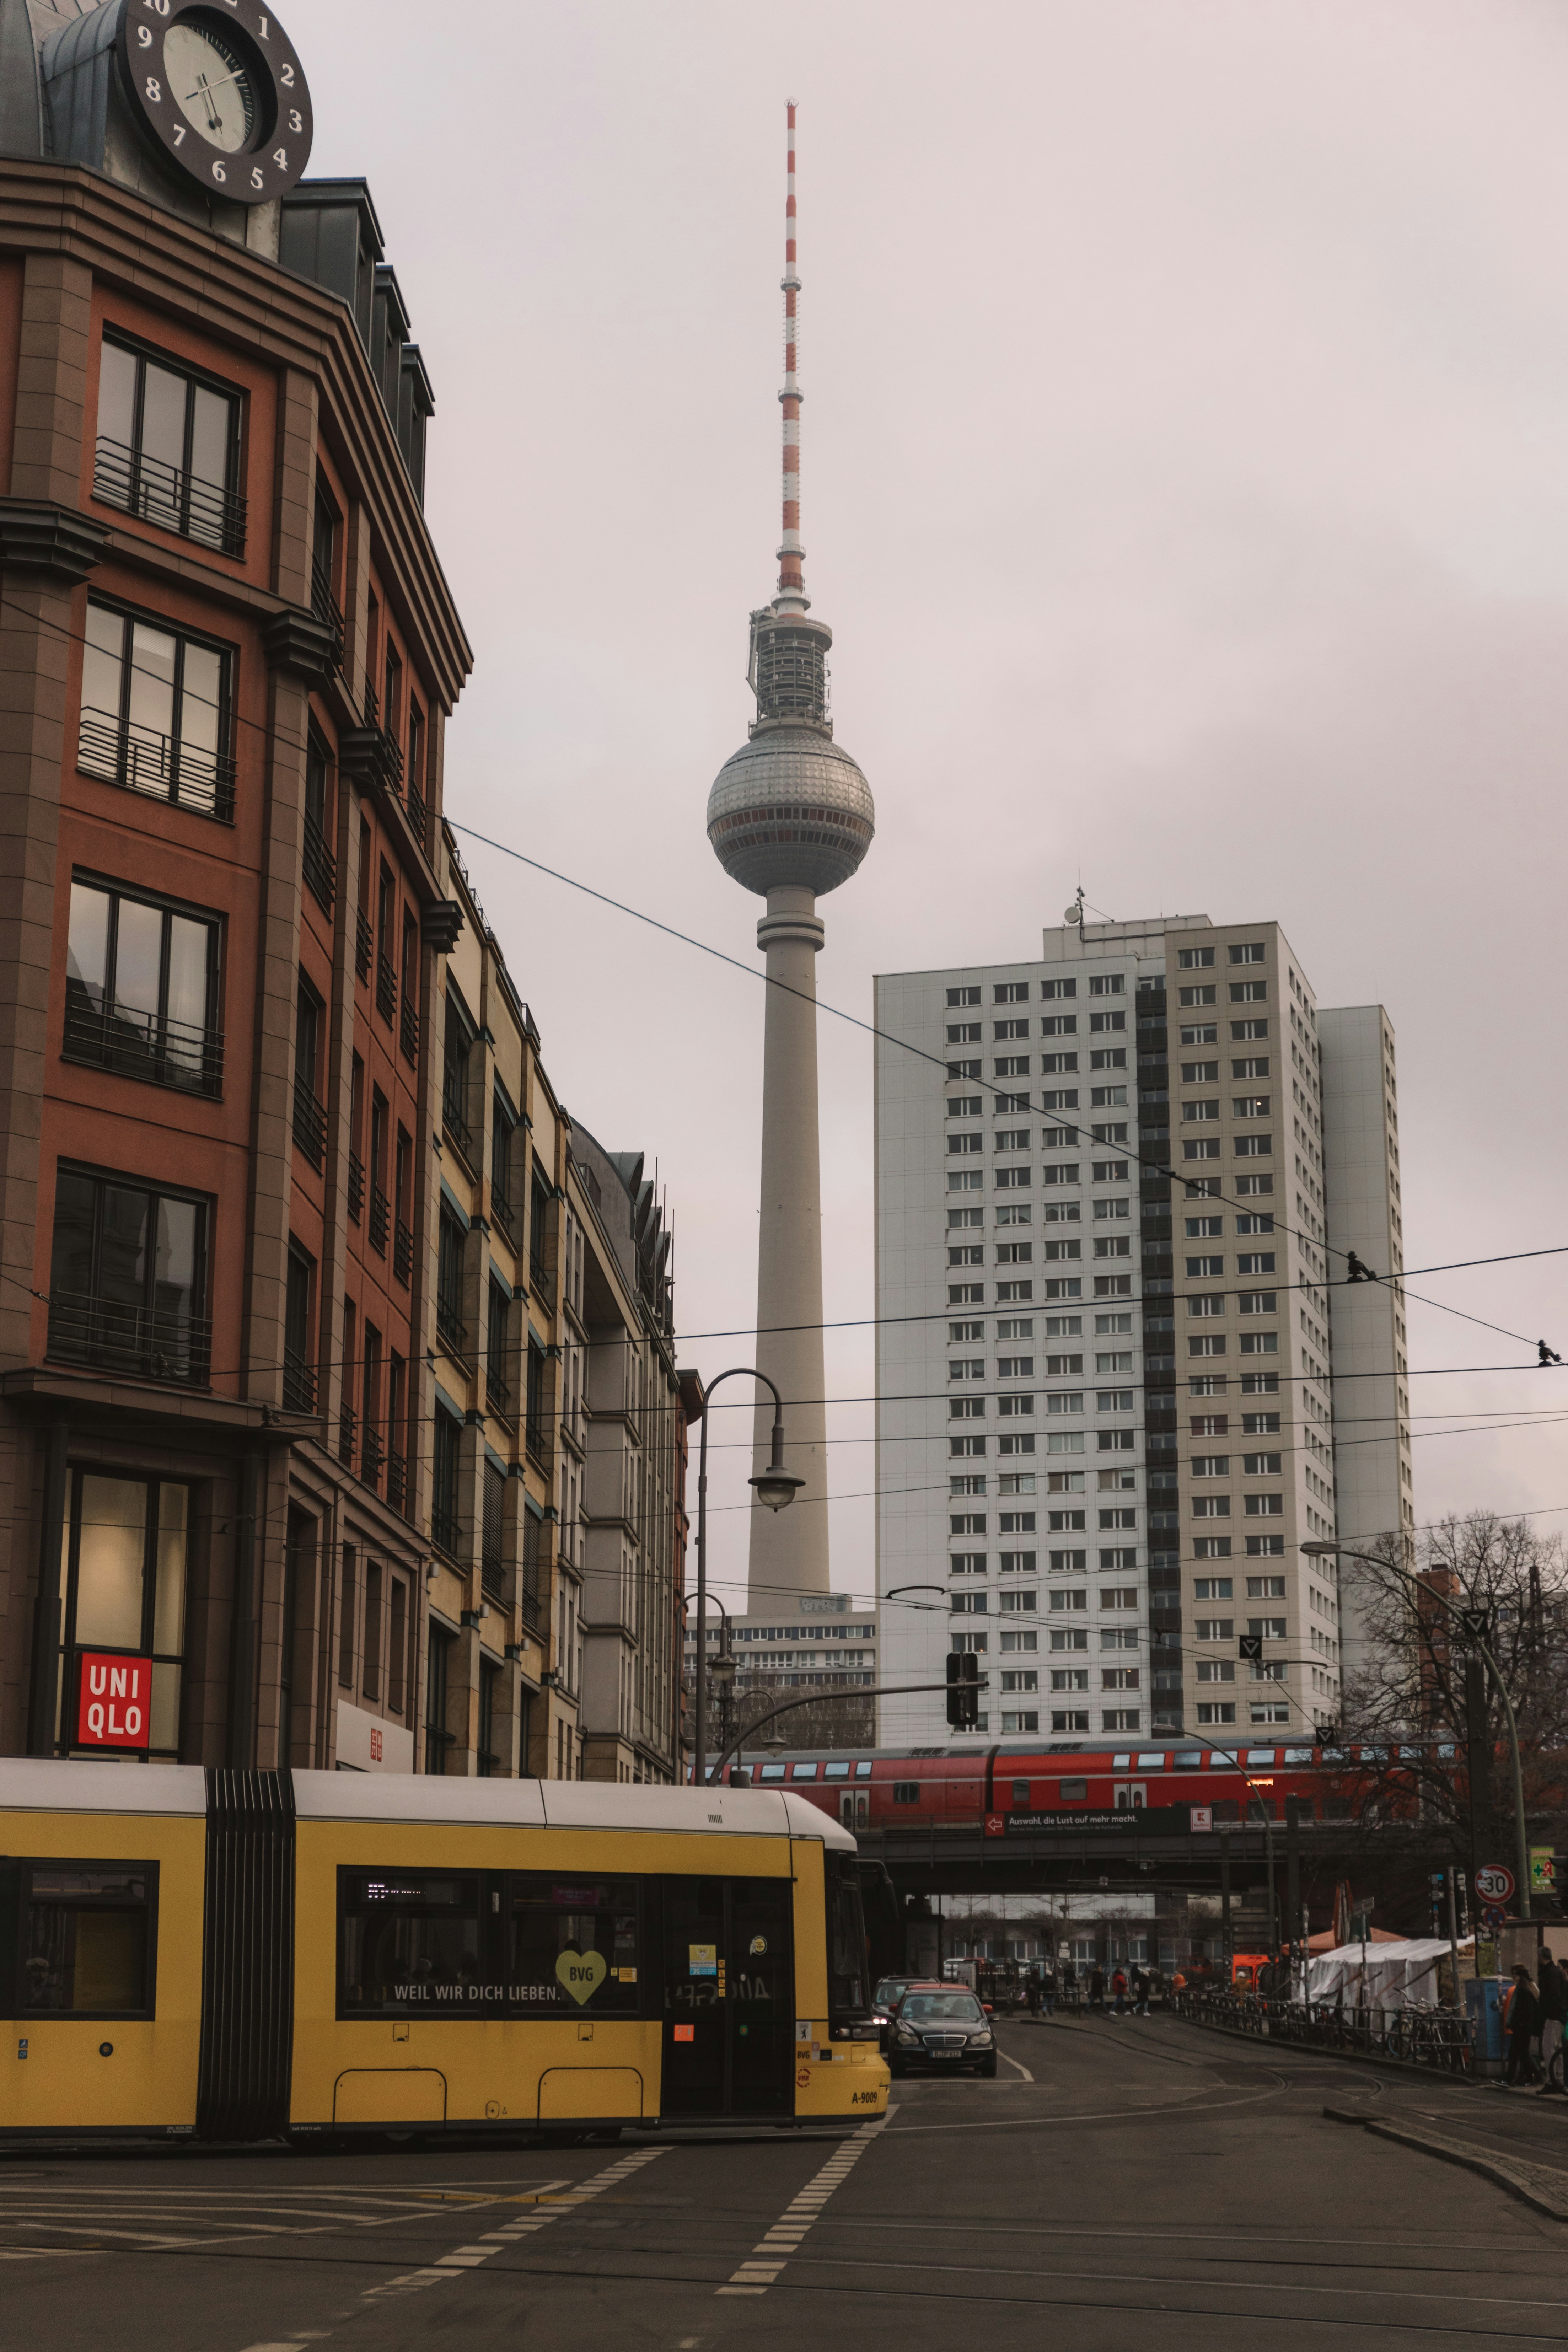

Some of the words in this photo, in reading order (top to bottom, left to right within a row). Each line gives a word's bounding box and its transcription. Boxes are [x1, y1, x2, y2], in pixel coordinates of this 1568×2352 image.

[138, 26, 152, 47] 9
[258, 16, 269, 40] 1
[280, 63, 294, 87] 2
[146, 77, 161, 102] 8
[289, 109, 302, 132] 3
[173, 123, 186, 146] 7
[273, 147, 288, 171] 4
[212, 160, 226, 182] 6
[250, 167, 263, 189] 5
[90, 1665, 139, 1699] UNI
[88, 1703, 141, 1739] QLO
[1009, 1817, 1042, 1826] Auswahl,
[1043, 1816, 1055, 1825] die
[1075, 1815, 1088, 1824] auf
[1090, 1815, 1110, 1824] mehr
[1112, 1814, 1138, 1822] macht.
[1484, 1876, 1505, 1893] 30
[570, 1967, 593, 1982] BVG
[394, 1986, 430, 2000] WEIL
[435, 1986, 463, 2000] WIR
[469, 1986, 503, 2000] DICH
[509, 1986, 561, 2001] LIEBEN.
[797, 2051, 810, 2059] BVG
[852, 2092, 878, 2104] A-9009
